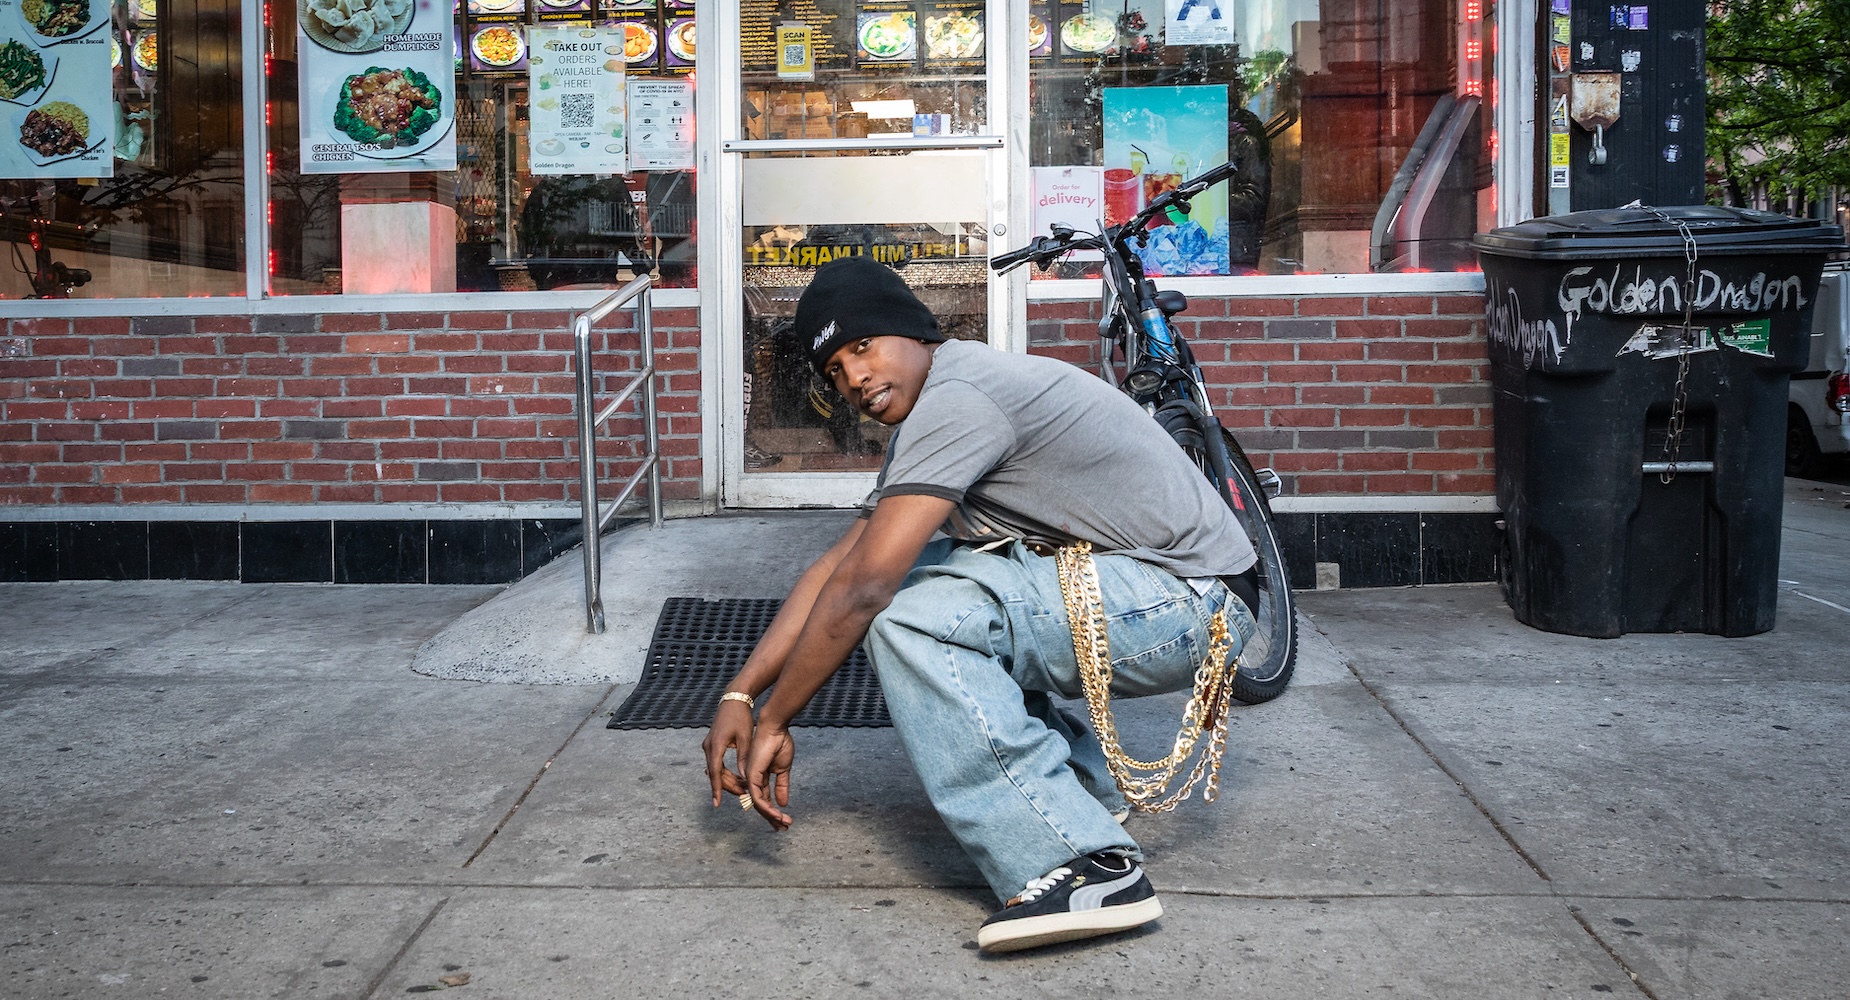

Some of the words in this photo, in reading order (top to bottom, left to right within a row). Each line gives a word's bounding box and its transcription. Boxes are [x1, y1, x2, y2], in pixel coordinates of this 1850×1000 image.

[383, 34, 412, 42] HOME
[414, 33, 442, 41] MADE
[383, 42, 440, 51] DUMPLINGS
[553, 43, 578, 52] TAKE
[581, 43, 602, 51] OUT
[558, 55, 597, 64] ORDERS
[553, 67, 602, 76] AVAILABLE
[563, 79, 592, 88] HERE!
[312, 144, 353, 152] GENERAL
[354, 143, 382, 151] TSO'S
[312, 153, 354, 161] CHICKEN
[1039, 192, 1096, 208] delivery
[1558, 263, 1682, 319] Golden
[1693, 269, 1808, 313] Dragon
